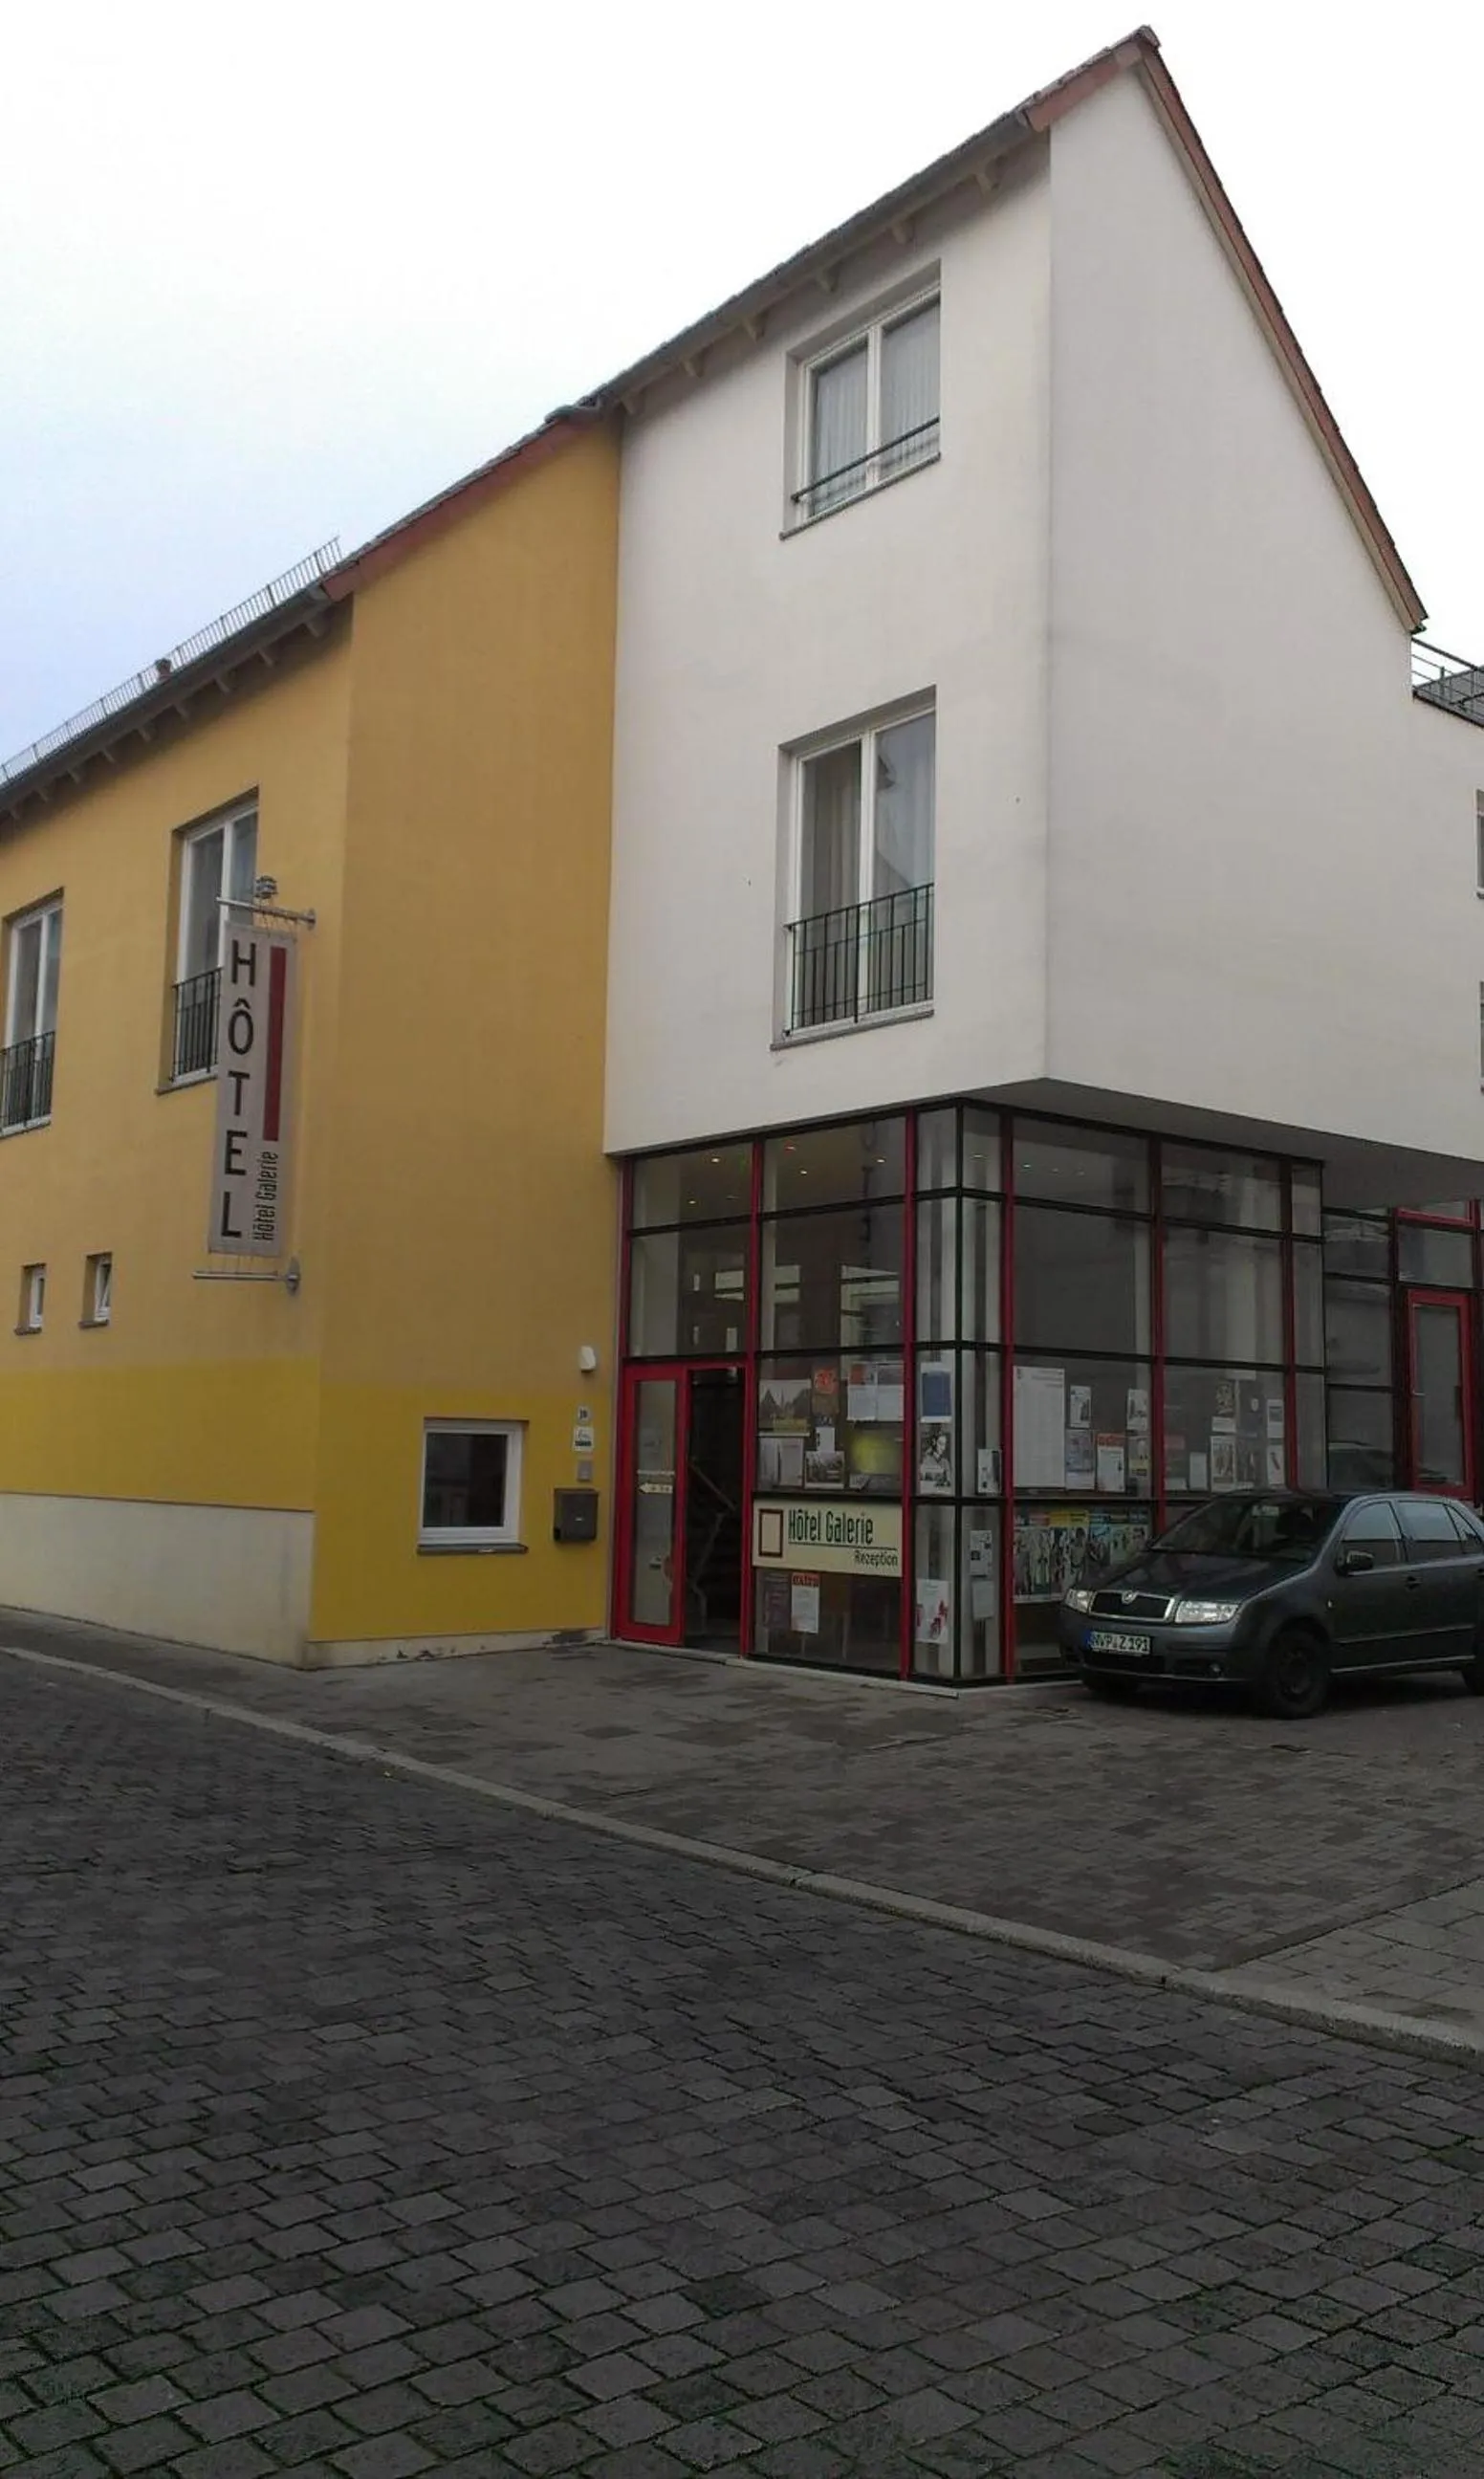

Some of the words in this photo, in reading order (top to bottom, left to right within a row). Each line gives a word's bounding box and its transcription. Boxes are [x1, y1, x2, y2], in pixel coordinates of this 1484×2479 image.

[221, 939, 256, 1239] HÔTEL
[253, 1151, 278, 1201] Galerie
[252, 1204, 275, 1241] Hôtel
[788, 1509, 820, 1541] Hôtel
[826, 1511, 873, 1545] Galerie
